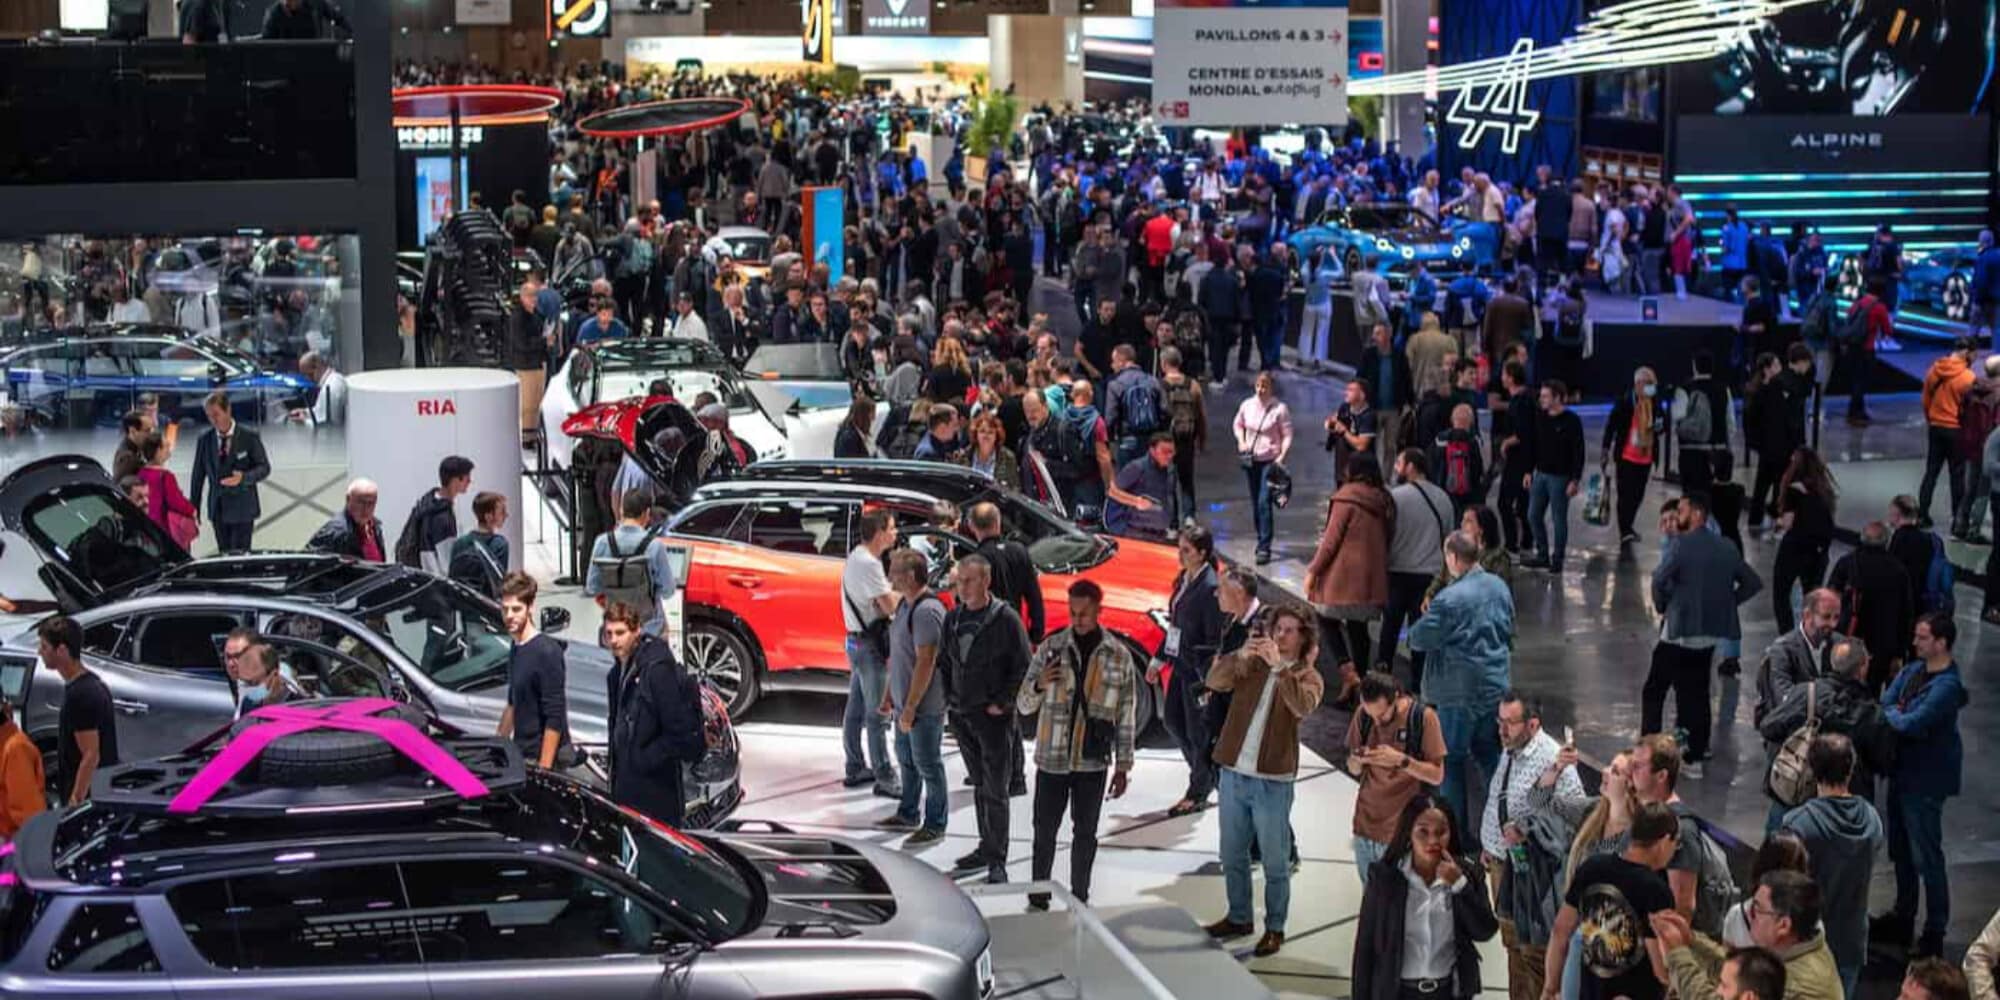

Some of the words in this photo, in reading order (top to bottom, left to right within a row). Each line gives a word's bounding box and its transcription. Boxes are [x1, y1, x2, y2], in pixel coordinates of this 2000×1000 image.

[1195, 30, 1281, 41] PAVILLONS
[1285, 30, 1296, 41] 4
[1300, 30, 1310, 41] &
[1314, 30, 1325, 41] 3
[1188, 68, 1250, 79] CENTRE
[1254, 67, 1324, 80] D'ESSAIS
[1189, 85, 1260, 96] MONDIAL
[1790, 133, 1882, 147] ALPINE
[417, 399, 456, 416] RIA
